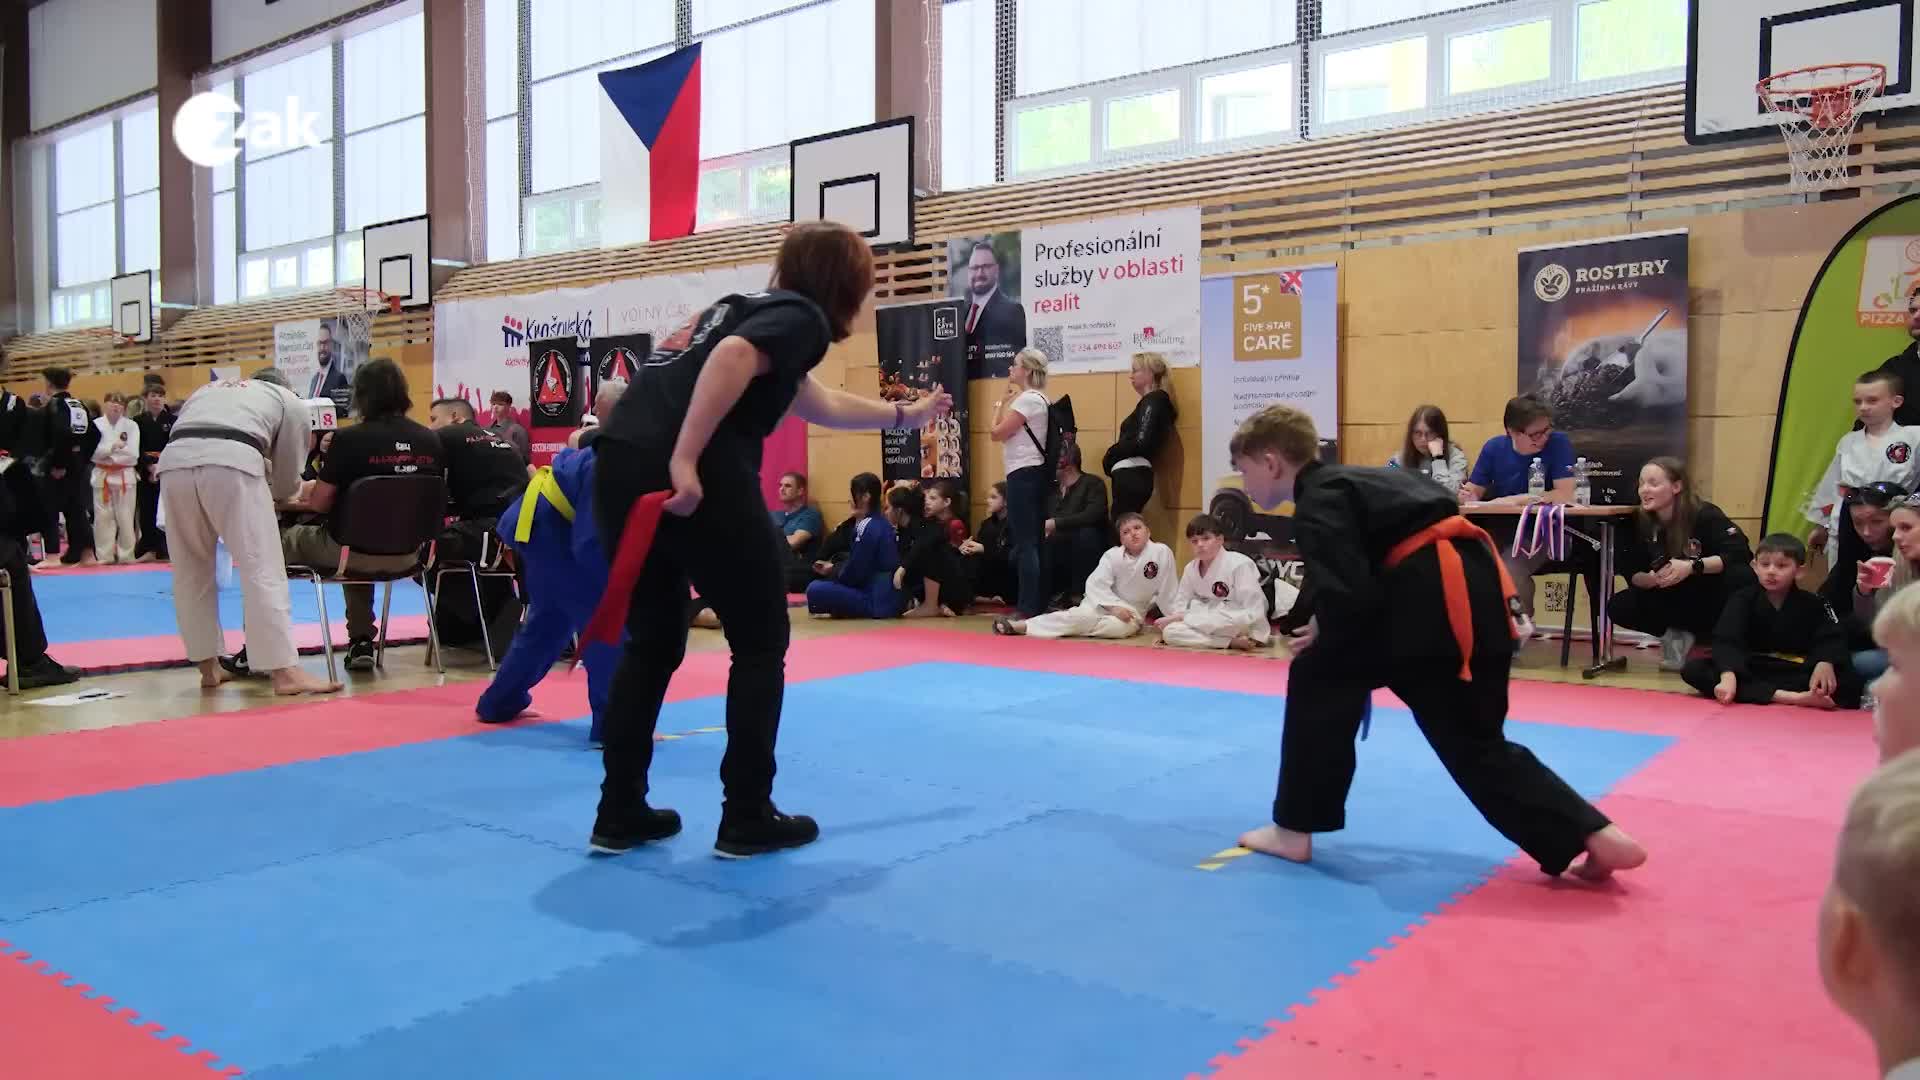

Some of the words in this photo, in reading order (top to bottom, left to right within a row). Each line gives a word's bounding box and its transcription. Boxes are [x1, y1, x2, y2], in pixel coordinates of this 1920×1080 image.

[1034, 228, 1162, 262] Profesionální
[1034, 266, 1094, 288] služby
[1098, 266, 1109, 280] v
[1113, 254, 1184, 280] oblasti
[1575, 259, 1670, 283] ROSTERY
[1034, 292, 1081, 313] realit
[1242, 283, 1263, 315] 5
[1243, 322, 1264, 332] FIVE
[1267, 321, 1292, 331] STAR
[1860, 312, 1905, 324] PIZZA
[1243, 333, 1294, 352] CARE
